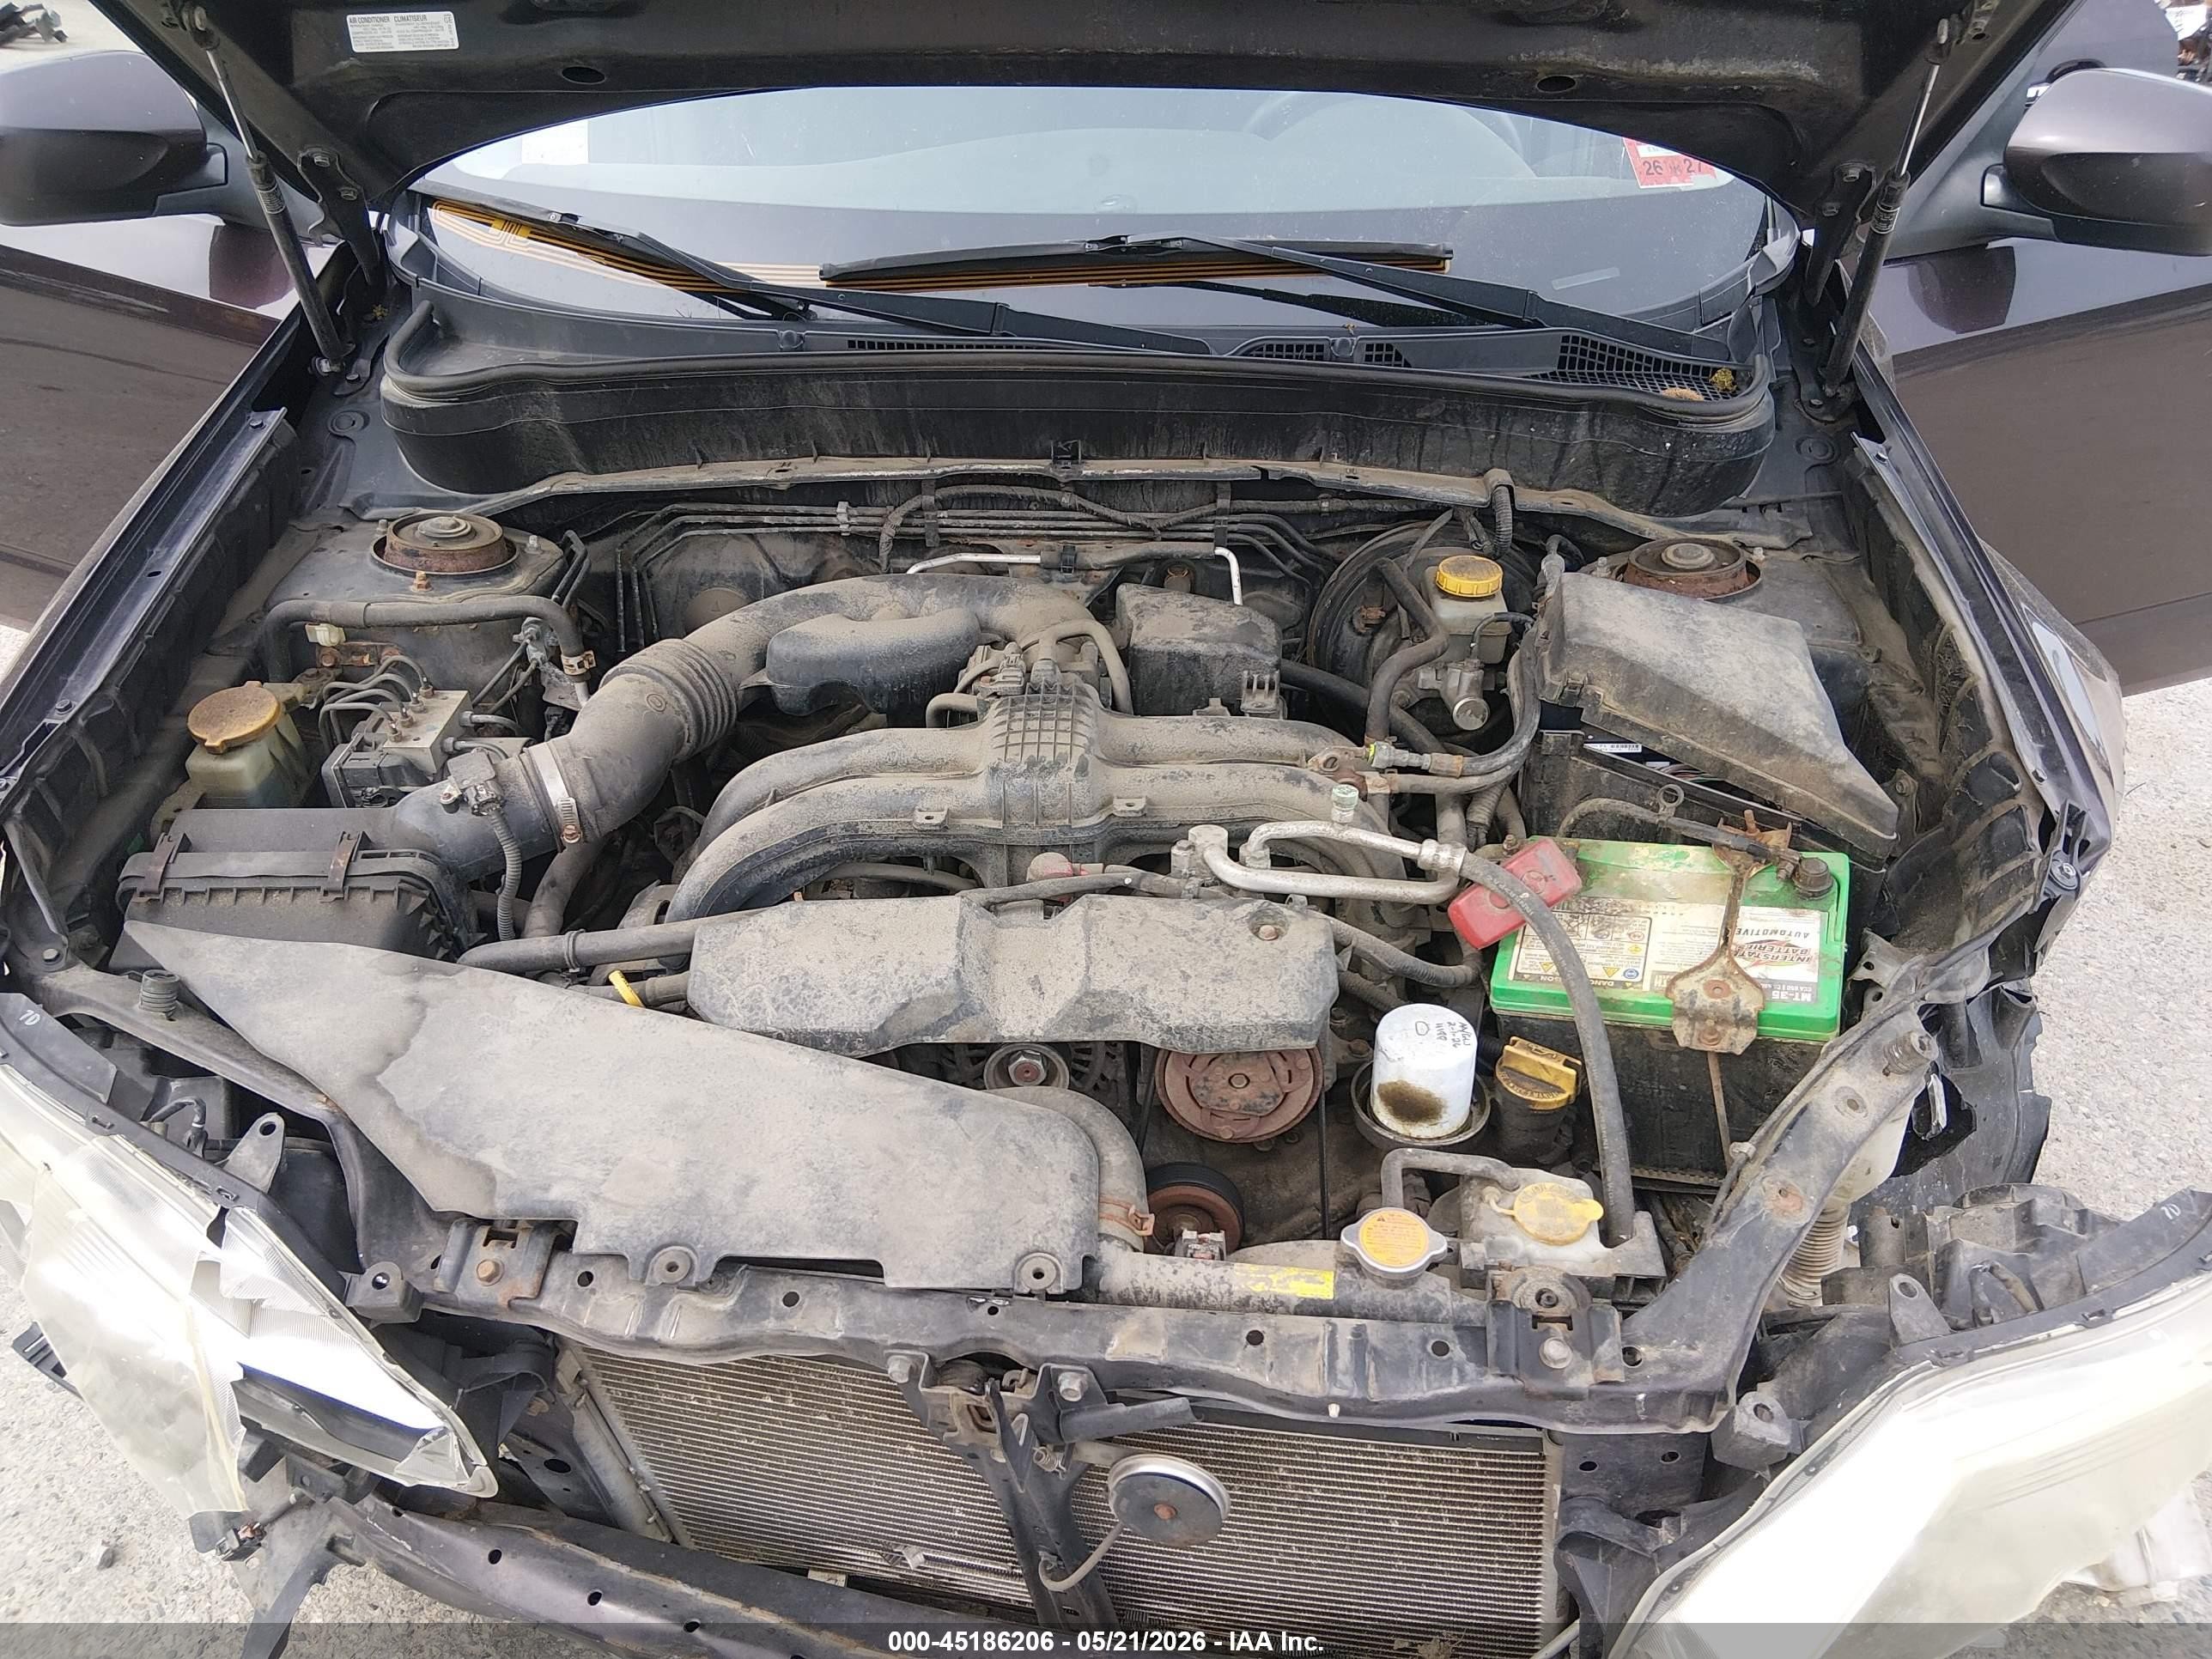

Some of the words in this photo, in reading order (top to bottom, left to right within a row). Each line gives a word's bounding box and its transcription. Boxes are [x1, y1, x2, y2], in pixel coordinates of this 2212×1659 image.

[1643, 160, 1663, 176] 26
[1735, 927, 1810, 939] AUTOMOTIVE
[1771, 990, 1813, 1002] MT-35
